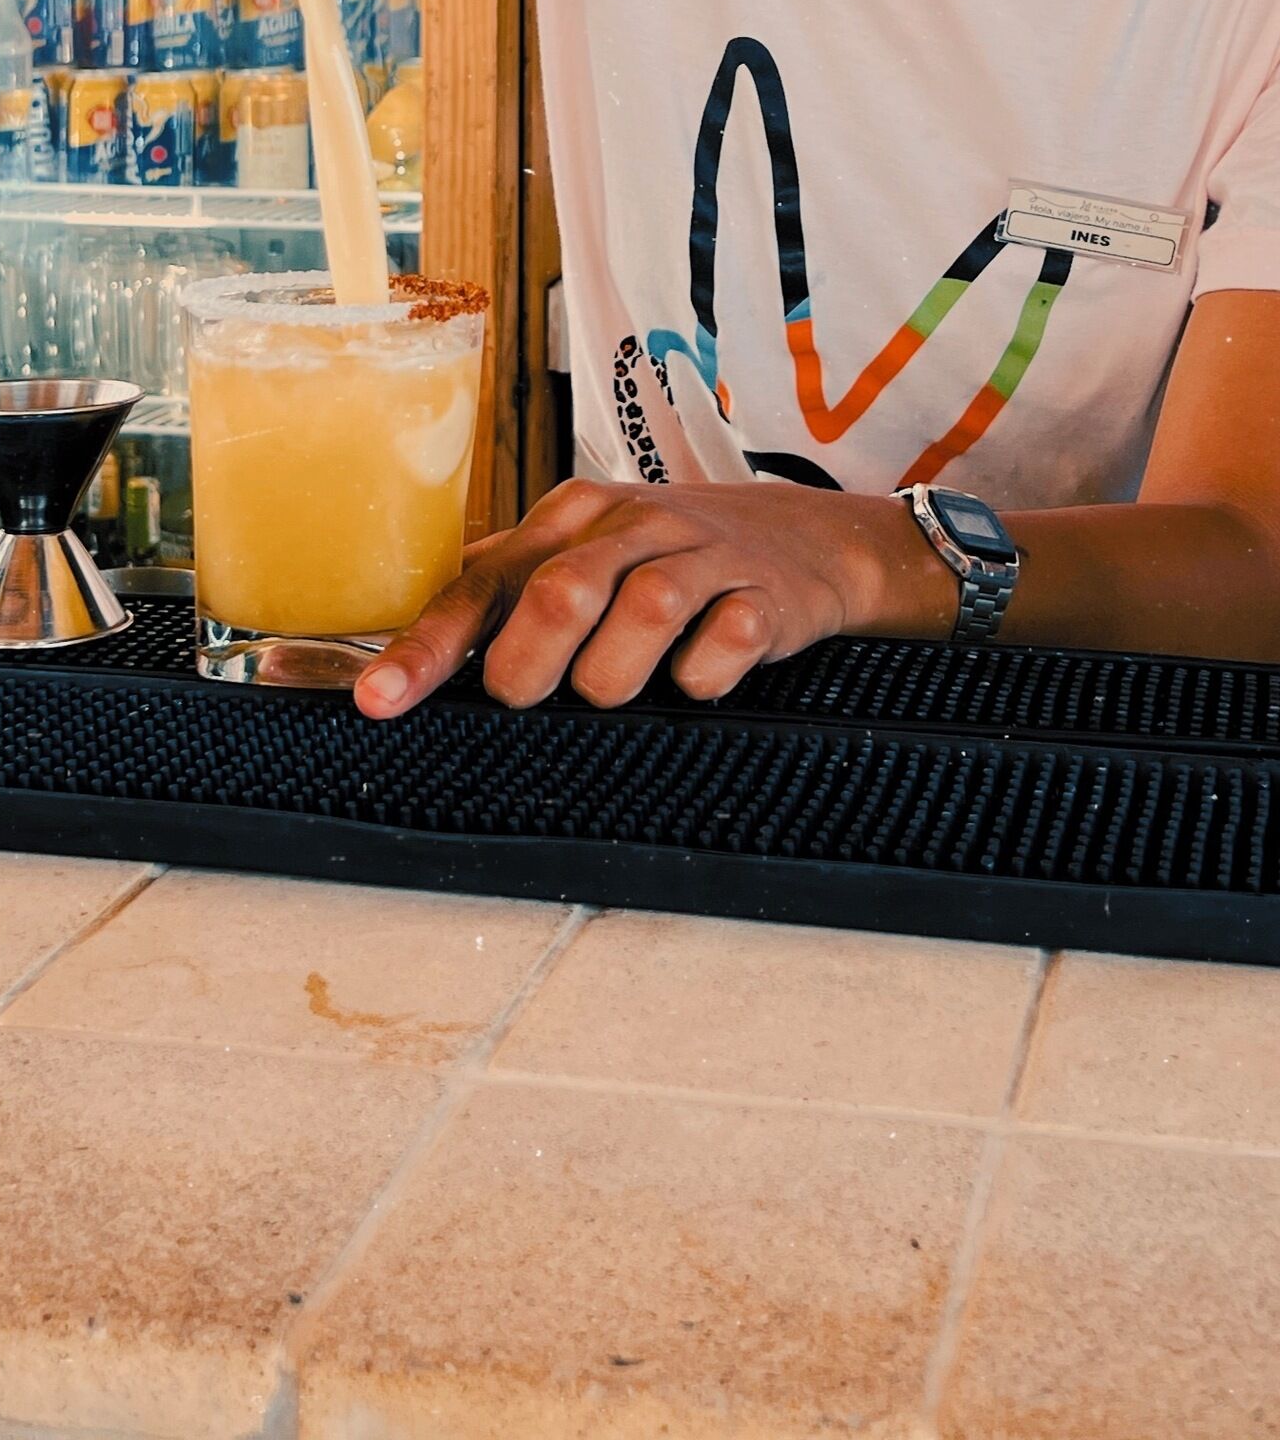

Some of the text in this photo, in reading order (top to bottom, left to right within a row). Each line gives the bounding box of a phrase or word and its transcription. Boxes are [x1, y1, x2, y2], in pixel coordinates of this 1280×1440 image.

[1095, 215, 1111, 227] My
[1112, 220, 1141, 232] name
[1070, 228, 1112, 248] INES
